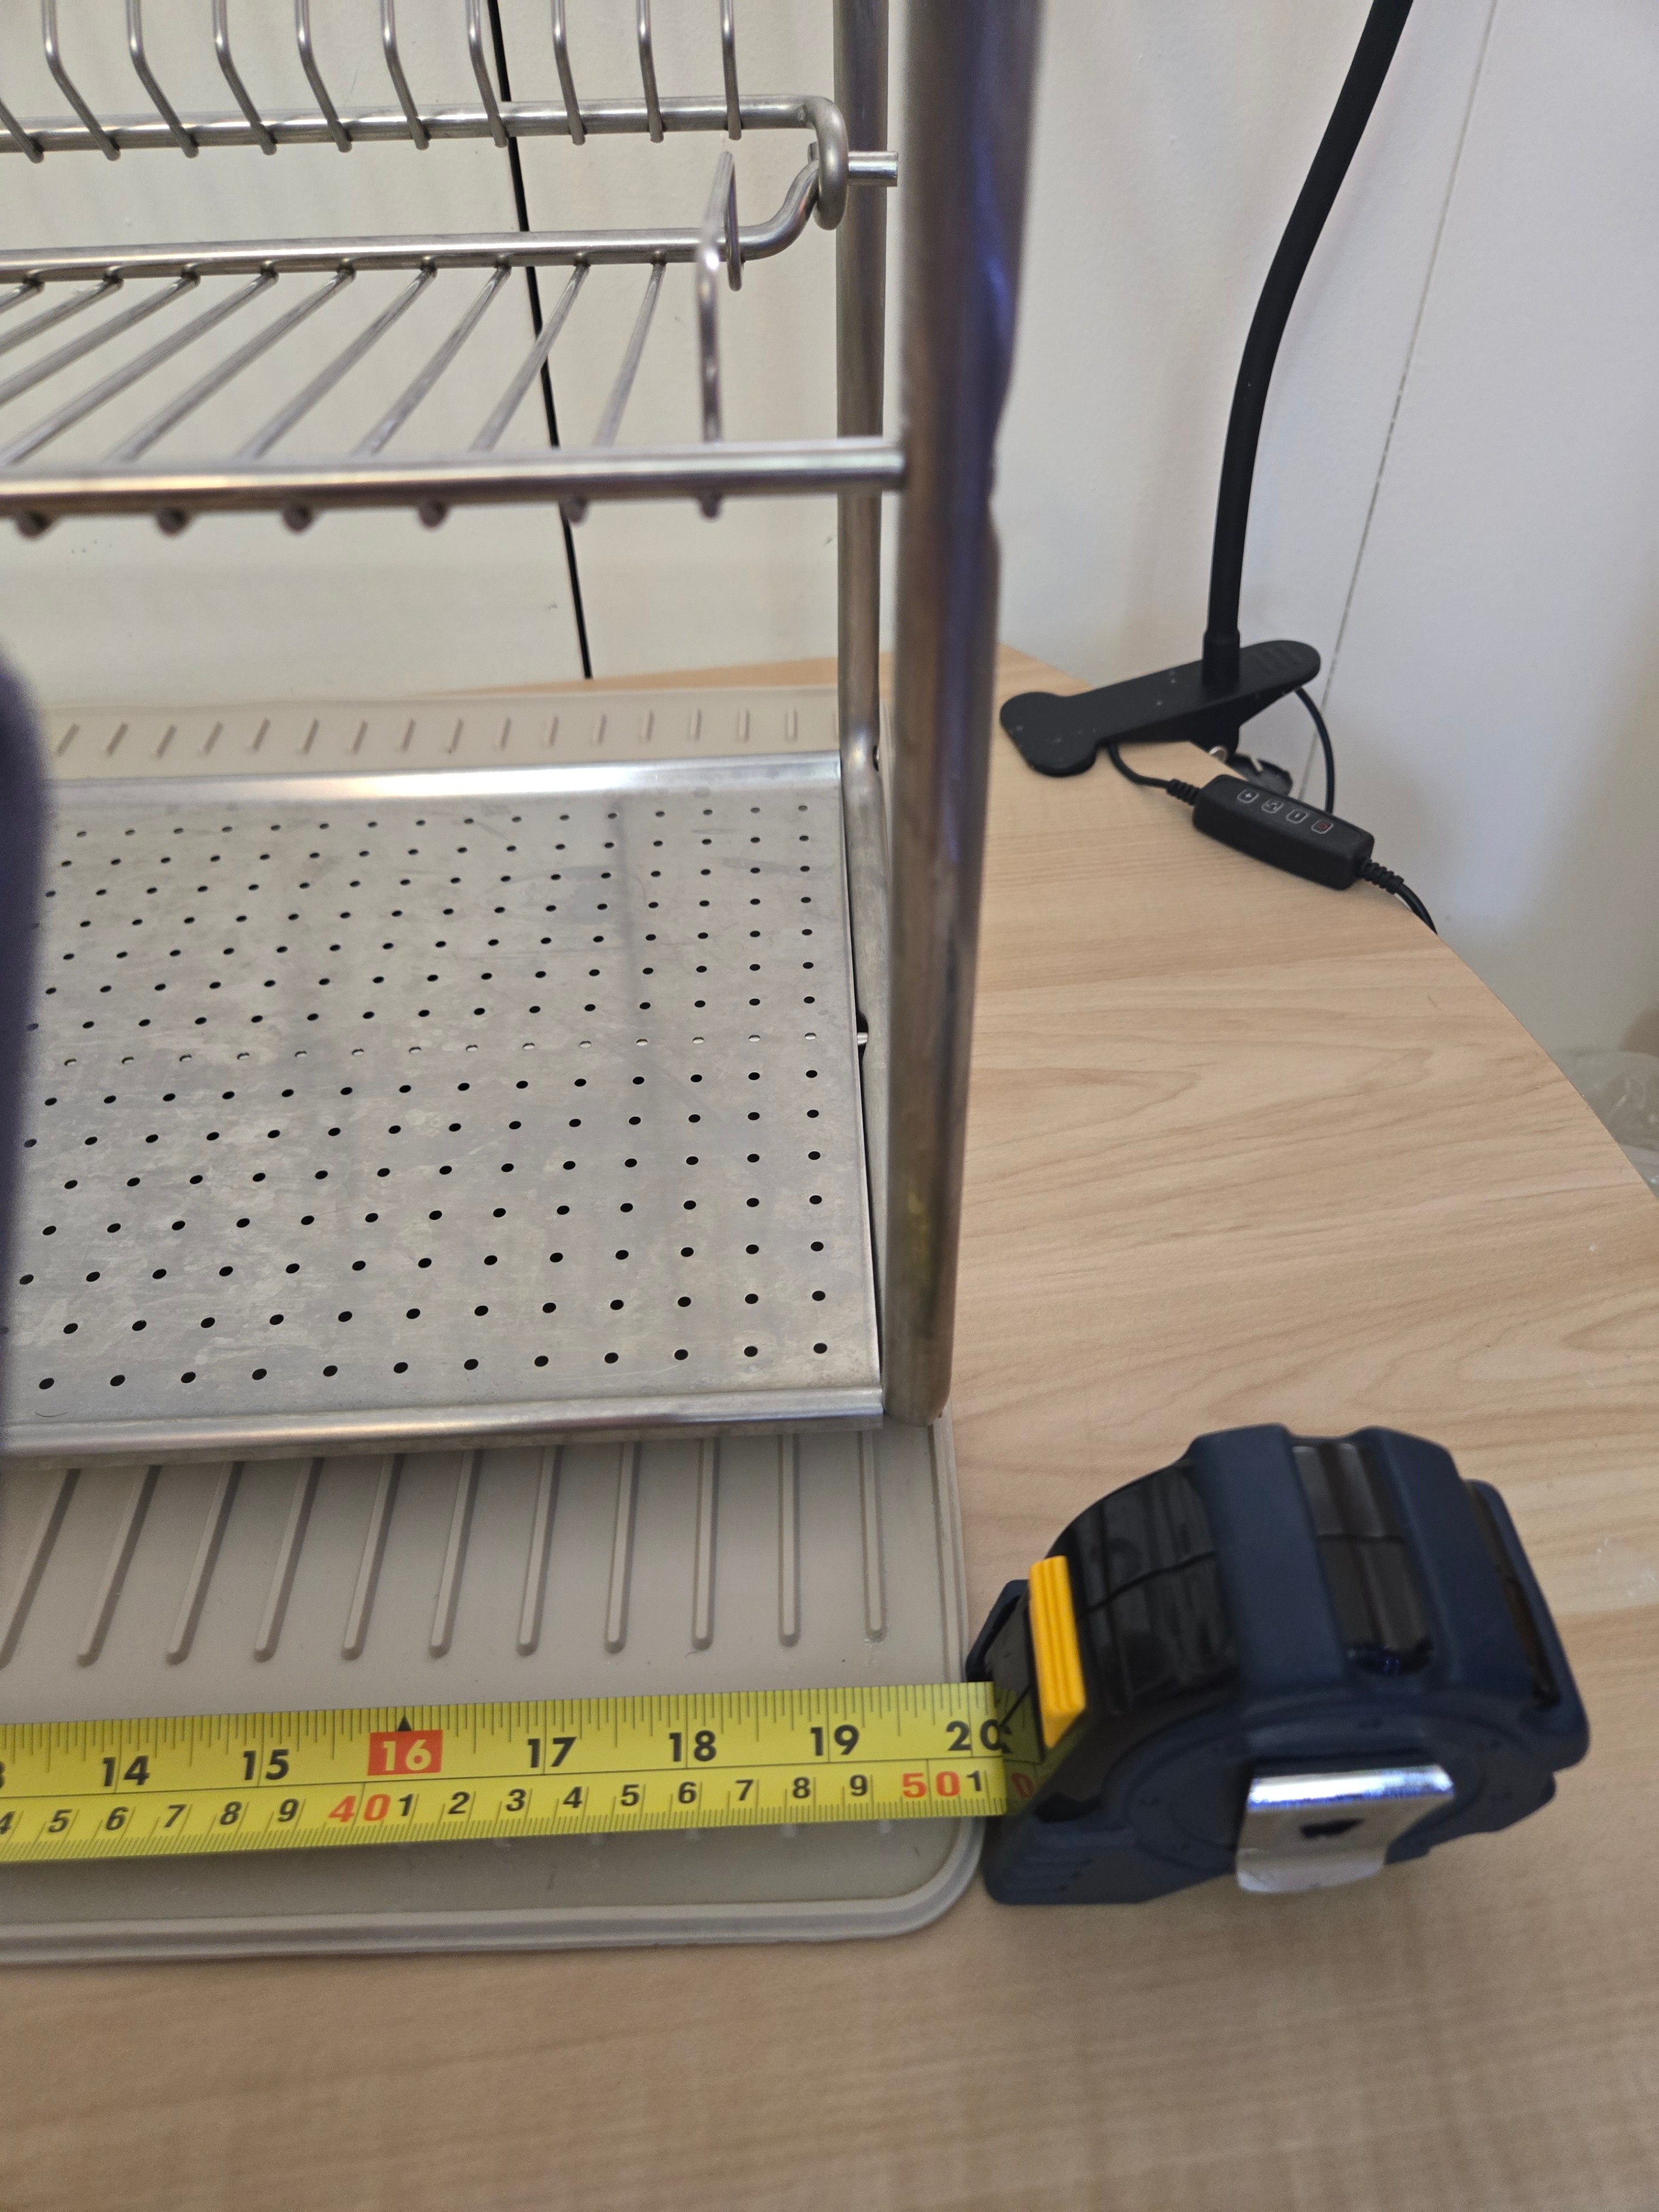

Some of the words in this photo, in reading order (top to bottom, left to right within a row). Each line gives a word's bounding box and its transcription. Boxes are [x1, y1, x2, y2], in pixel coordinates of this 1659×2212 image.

[101, 1756, 150, 1786] 14
[243, 1749, 289, 1780] 15
[382, 1739, 431, 1771] 16
[527, 1736, 576, 1768] 17
[669, 1730, 717, 1762] 18
[810, 1724, 860, 1756] 19
[946, 1720, 1002, 1752] 20
[48, 1809, 72, 1832] 5
[105, 1806, 129, 1831] 6
[164, 1805, 186, 1828] 7
[219, 1801, 243, 1825] 8
[277, 1798, 299, 1823] 9
[328, 1793, 391, 1823] 40
[398, 1793, 414, 1816] 1
[448, 1791, 470, 1814] 2
[506, 1788, 526, 1812] 3
[563, 1786, 583, 1809] 4
[620, 1784, 640, 1806] 5
[678, 1781, 697, 1804] 6
[735, 1779, 754, 1801] 7
[792, 1777, 810, 1798] 8
[849, 1774, 868, 1796] 9
[902, 1771, 960, 1798] 50
[966, 1770, 982, 1791] 1
